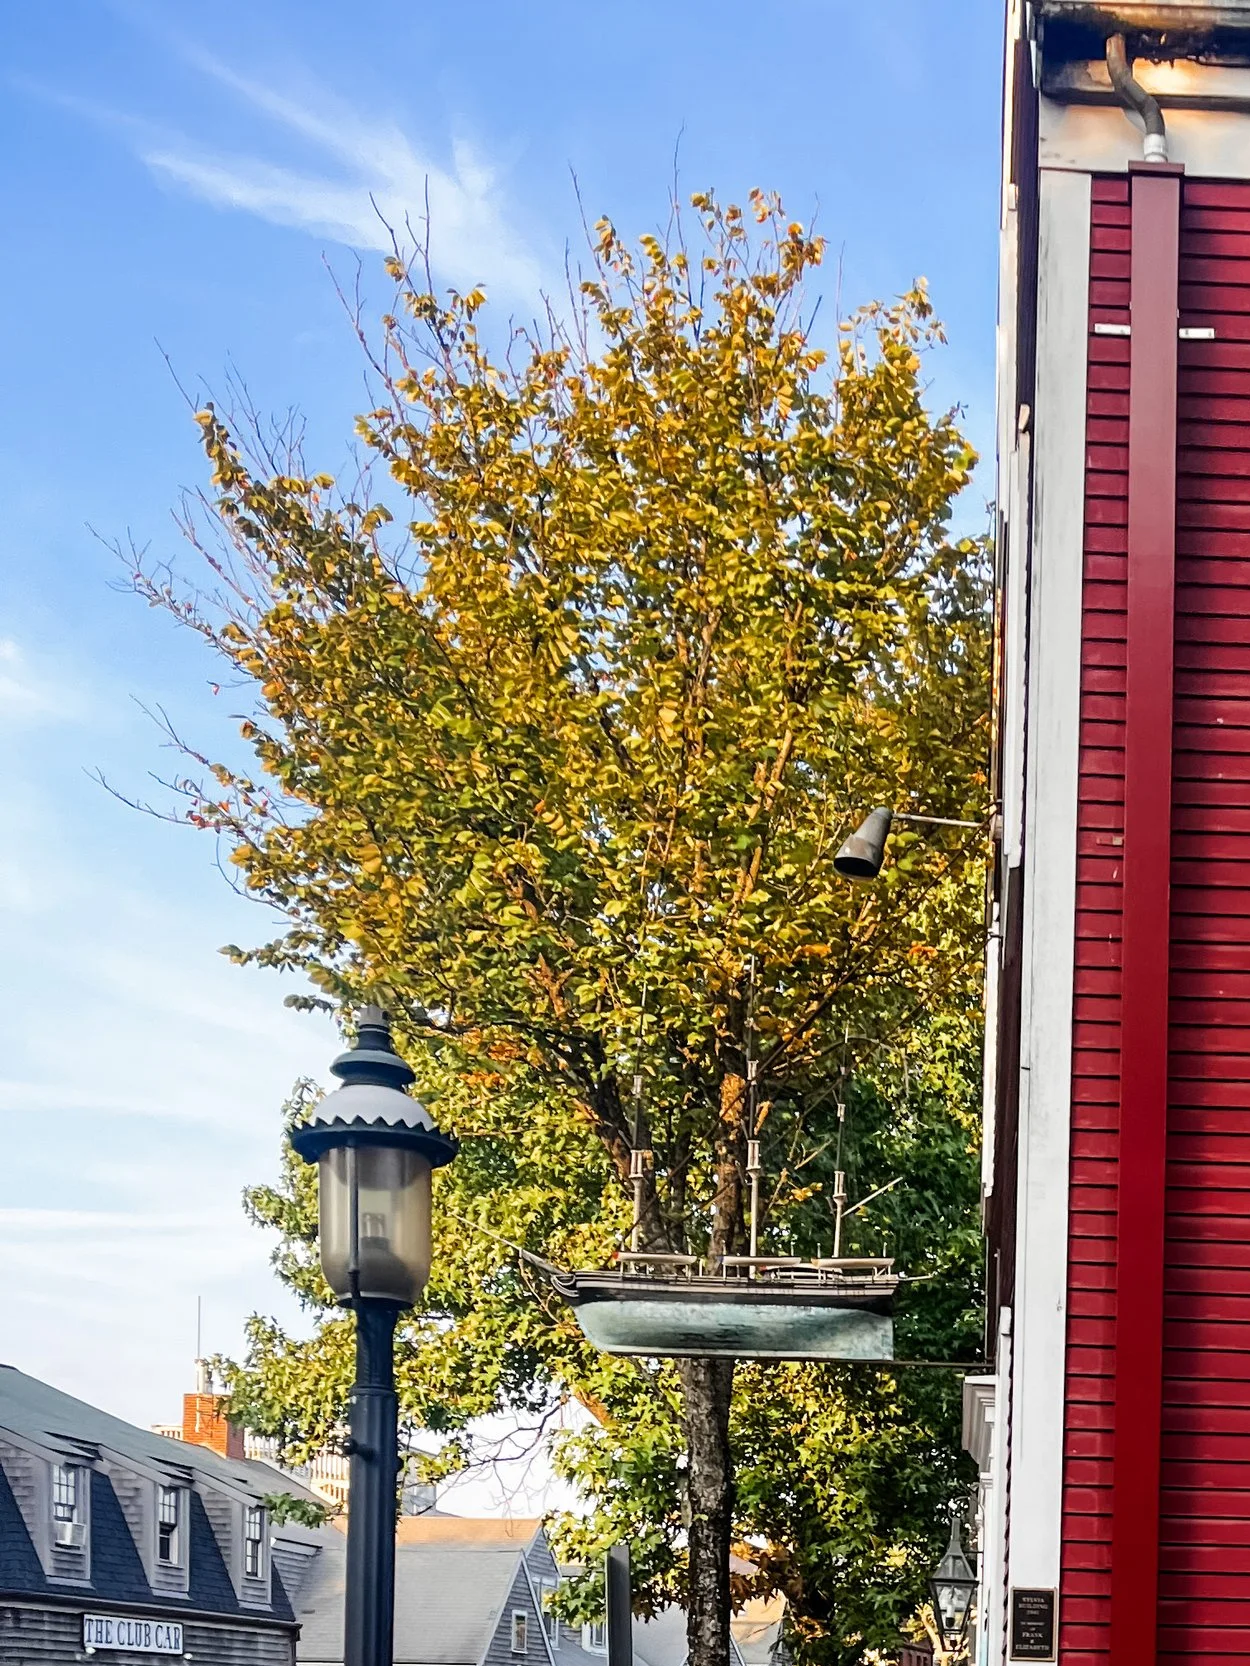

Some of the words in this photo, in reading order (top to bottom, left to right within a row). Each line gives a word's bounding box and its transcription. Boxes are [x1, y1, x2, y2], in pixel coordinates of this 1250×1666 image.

[85, 1618, 113, 1644] THE
[117, 1620, 151, 1647] CLUB
[155, 1625, 181, 1649] CAR
